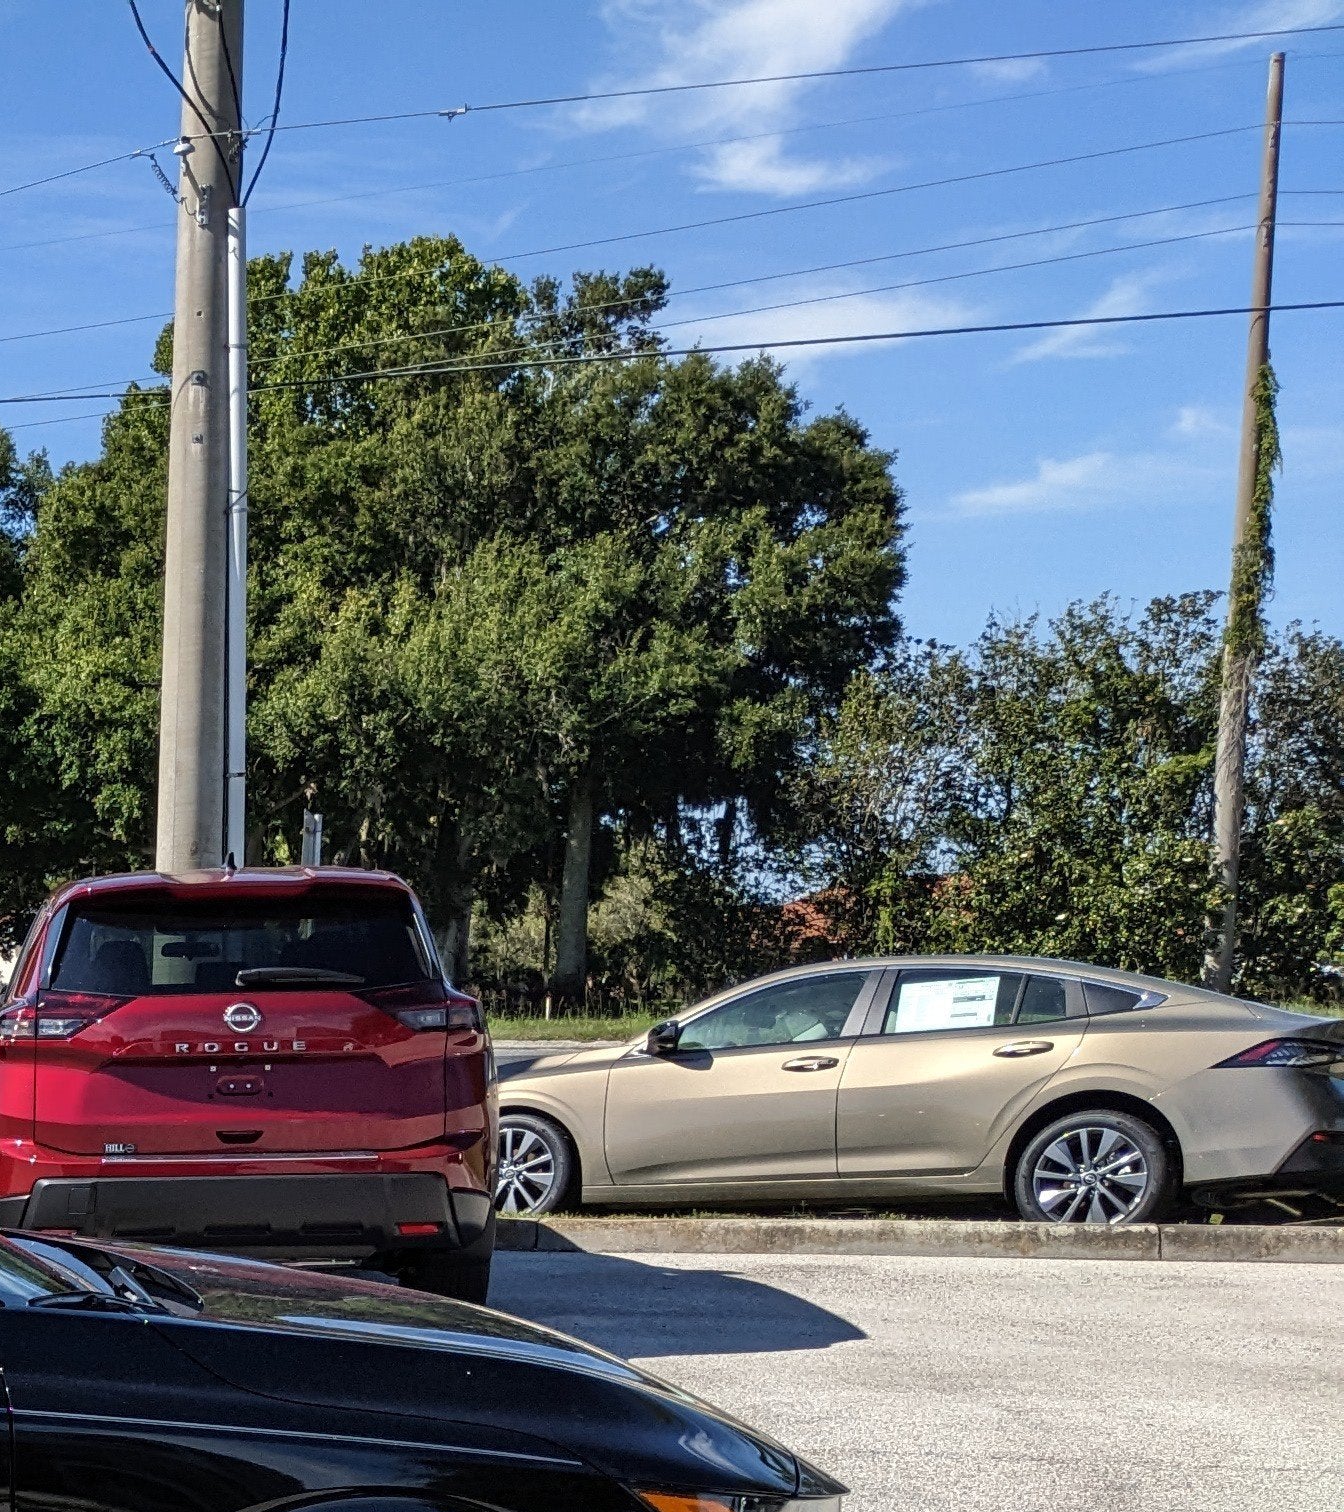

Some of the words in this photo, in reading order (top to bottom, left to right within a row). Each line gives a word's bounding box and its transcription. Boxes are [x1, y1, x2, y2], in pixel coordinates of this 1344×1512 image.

[223, 1013, 261, 1022] NISSAN
[175, 1040, 307, 1053] ROGUE
[105, 1143, 125, 1153] HILL
